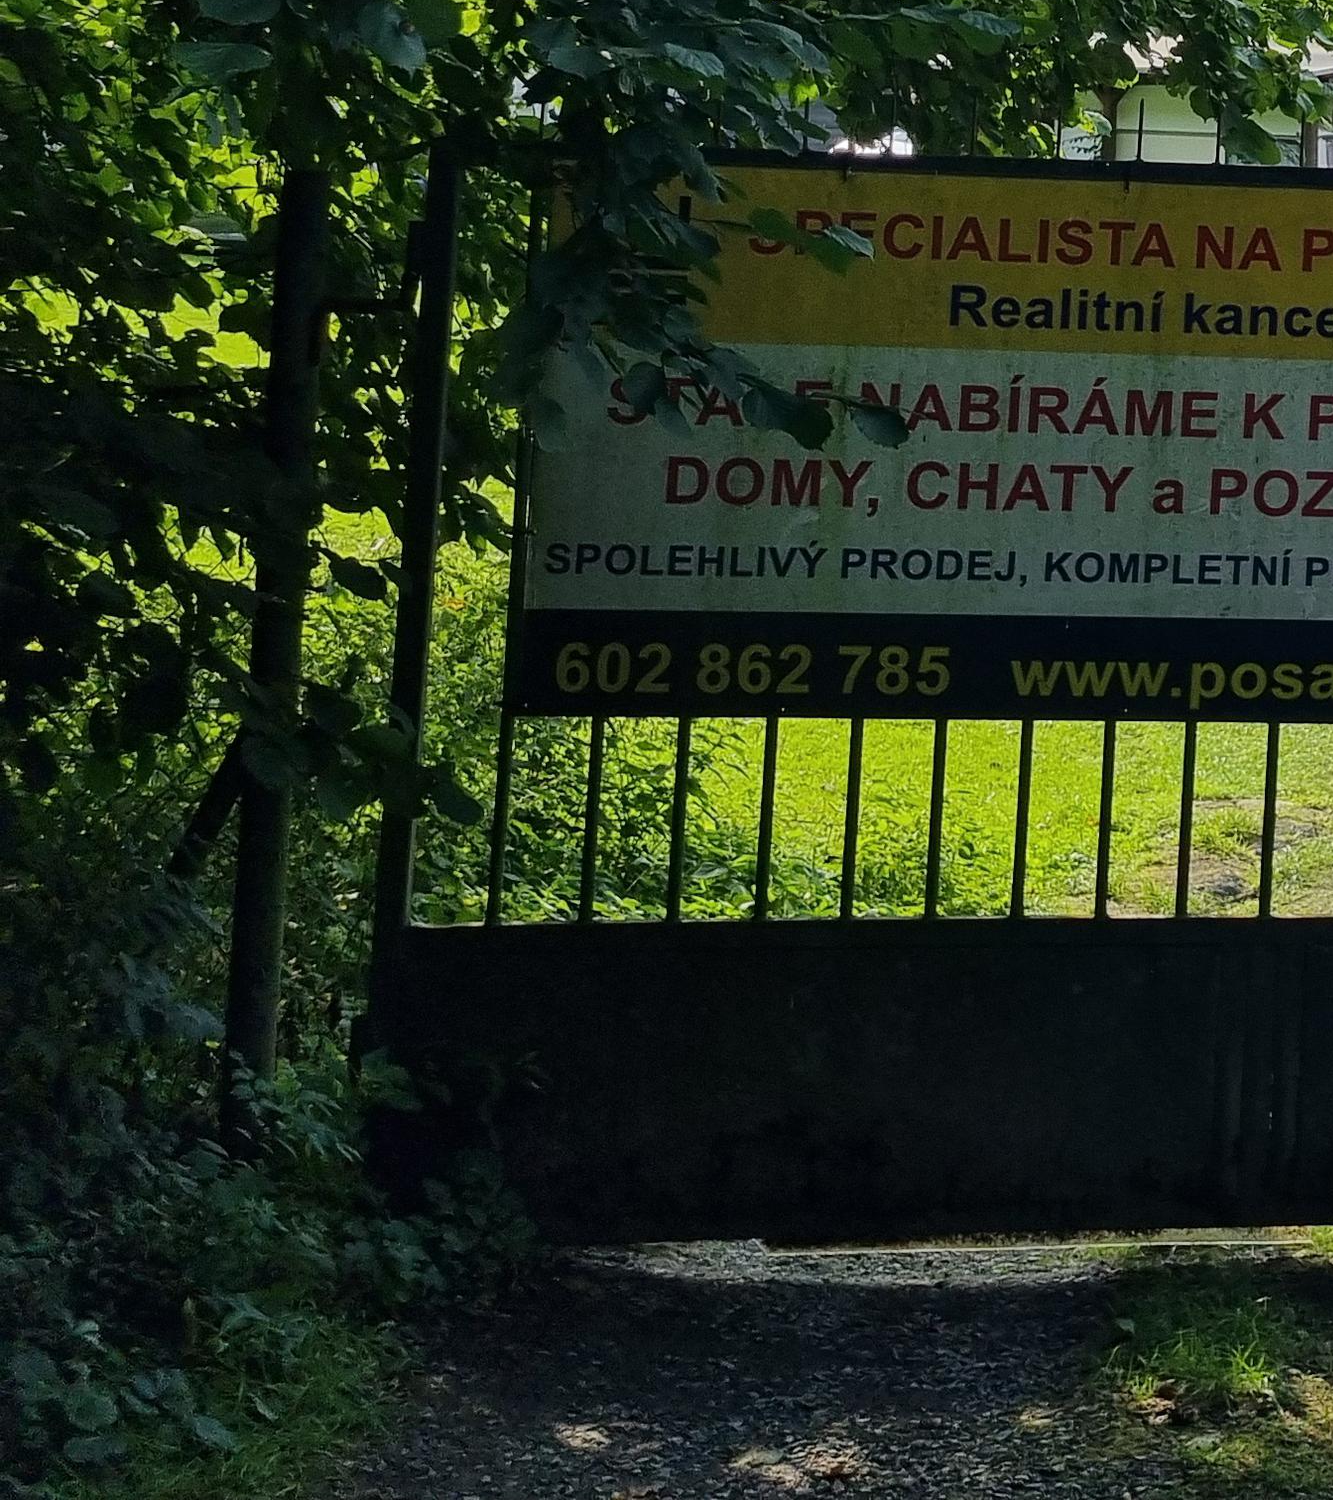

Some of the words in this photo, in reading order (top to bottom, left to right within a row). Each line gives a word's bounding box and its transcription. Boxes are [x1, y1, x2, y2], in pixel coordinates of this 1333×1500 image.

[1196, 225, 1281, 271] NA
[950, 285, 1165, 332] Realitní
[1243, 393, 1286, 440] K
[665, 456, 879, 516] DOMY,
[906, 462, 1134, 513] CHATY
[1153, 478, 1185, 515] a
[545, 540, 827, 579] SPOLEHLIVÝ
[841, 549, 1027, 587] PRODEJ,
[1044, 549, 1292, 586] KOMPLETNÍ
[556, 642, 673, 695] 602
[696, 643, 813, 695] 862
[838, 645, 951, 697] 785
